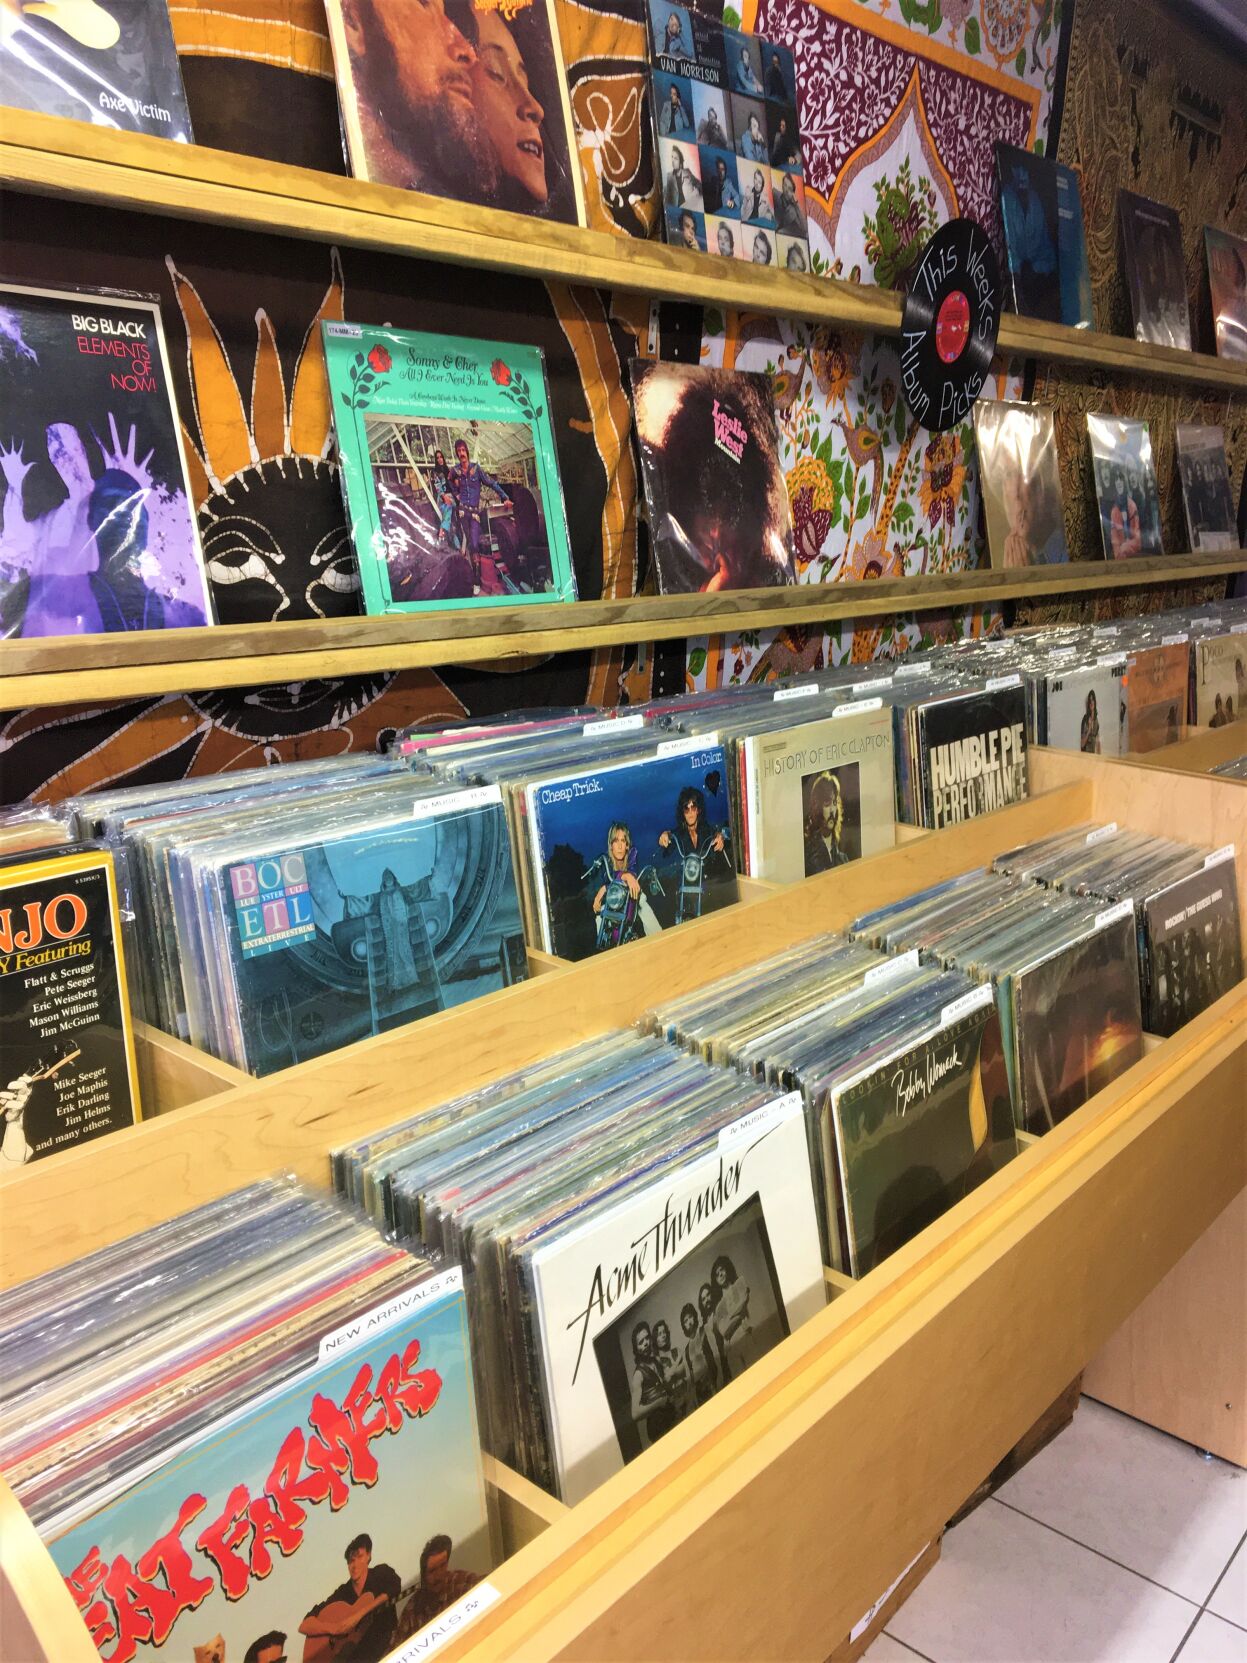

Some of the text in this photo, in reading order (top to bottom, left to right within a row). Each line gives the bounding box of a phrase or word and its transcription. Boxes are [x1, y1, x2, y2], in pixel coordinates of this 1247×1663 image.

[661, 57, 720, 83] VAN MORRISON
[99, 92, 171, 122] Axe Victim
[912, 228, 995, 340] This Weeks
[72, 314, 146, 338] BIG BLACK
[78, 336, 150, 360] ELEMENTS
[406, 347, 478, 374] Sonny & Cher
[132, 360, 152, 376] OF
[425, 369, 443, 382] Ever
[444, 372, 466, 386] Need
[476, 372, 488, 386] You
[901, 330, 982, 428] Album Picks
[110, 373, 157, 392] NOW!
[712, 398, 748, 444] Leslie
[714, 418, 744, 458] West
[691, 756, 700, 768] In
[764, 751, 807, 777] HISTORY
[810, 747, 823, 764] OF
[826, 742, 847, 760] ERIC
[848, 734, 890, 754] CLAPTON
[930, 722, 1025, 791] HUMBLE PIE
[542, 778, 604, 804] Cheap Trick.
[262, 889, 284, 902] YSTER
[16, 939, 92, 972] Featuring
[24, 962, 94, 989] Flatt & Scruggs
[44, 976, 96, 996] Pete Seeger
[32, 987, 98, 1013] Eric Weissberg
[29, 1000, 98, 1028] Mason Williams
[40, 1013, 100, 1038] Jim McGuinn
[54, 1066, 106, 1092] Mike Seeger
[59, 1078, 108, 1104] Joe Maphis
[891, 1043, 962, 1117] Bobby Womack
[56, 1092, 110, 1117] Erik Darling
[65, 1103, 110, 1127] Jim Helms
[740, 1110, 768, 1130] MUSIC
[36, 1118, 112, 1151] and many others.
[566, 1121, 784, 1386] Acme Thunder
[325, 1283, 440, 1352] NEW ARRIVALS
[197, 1338, 443, 1601] FARMERS
[396, 1614, 461, 1663] RIVALS
